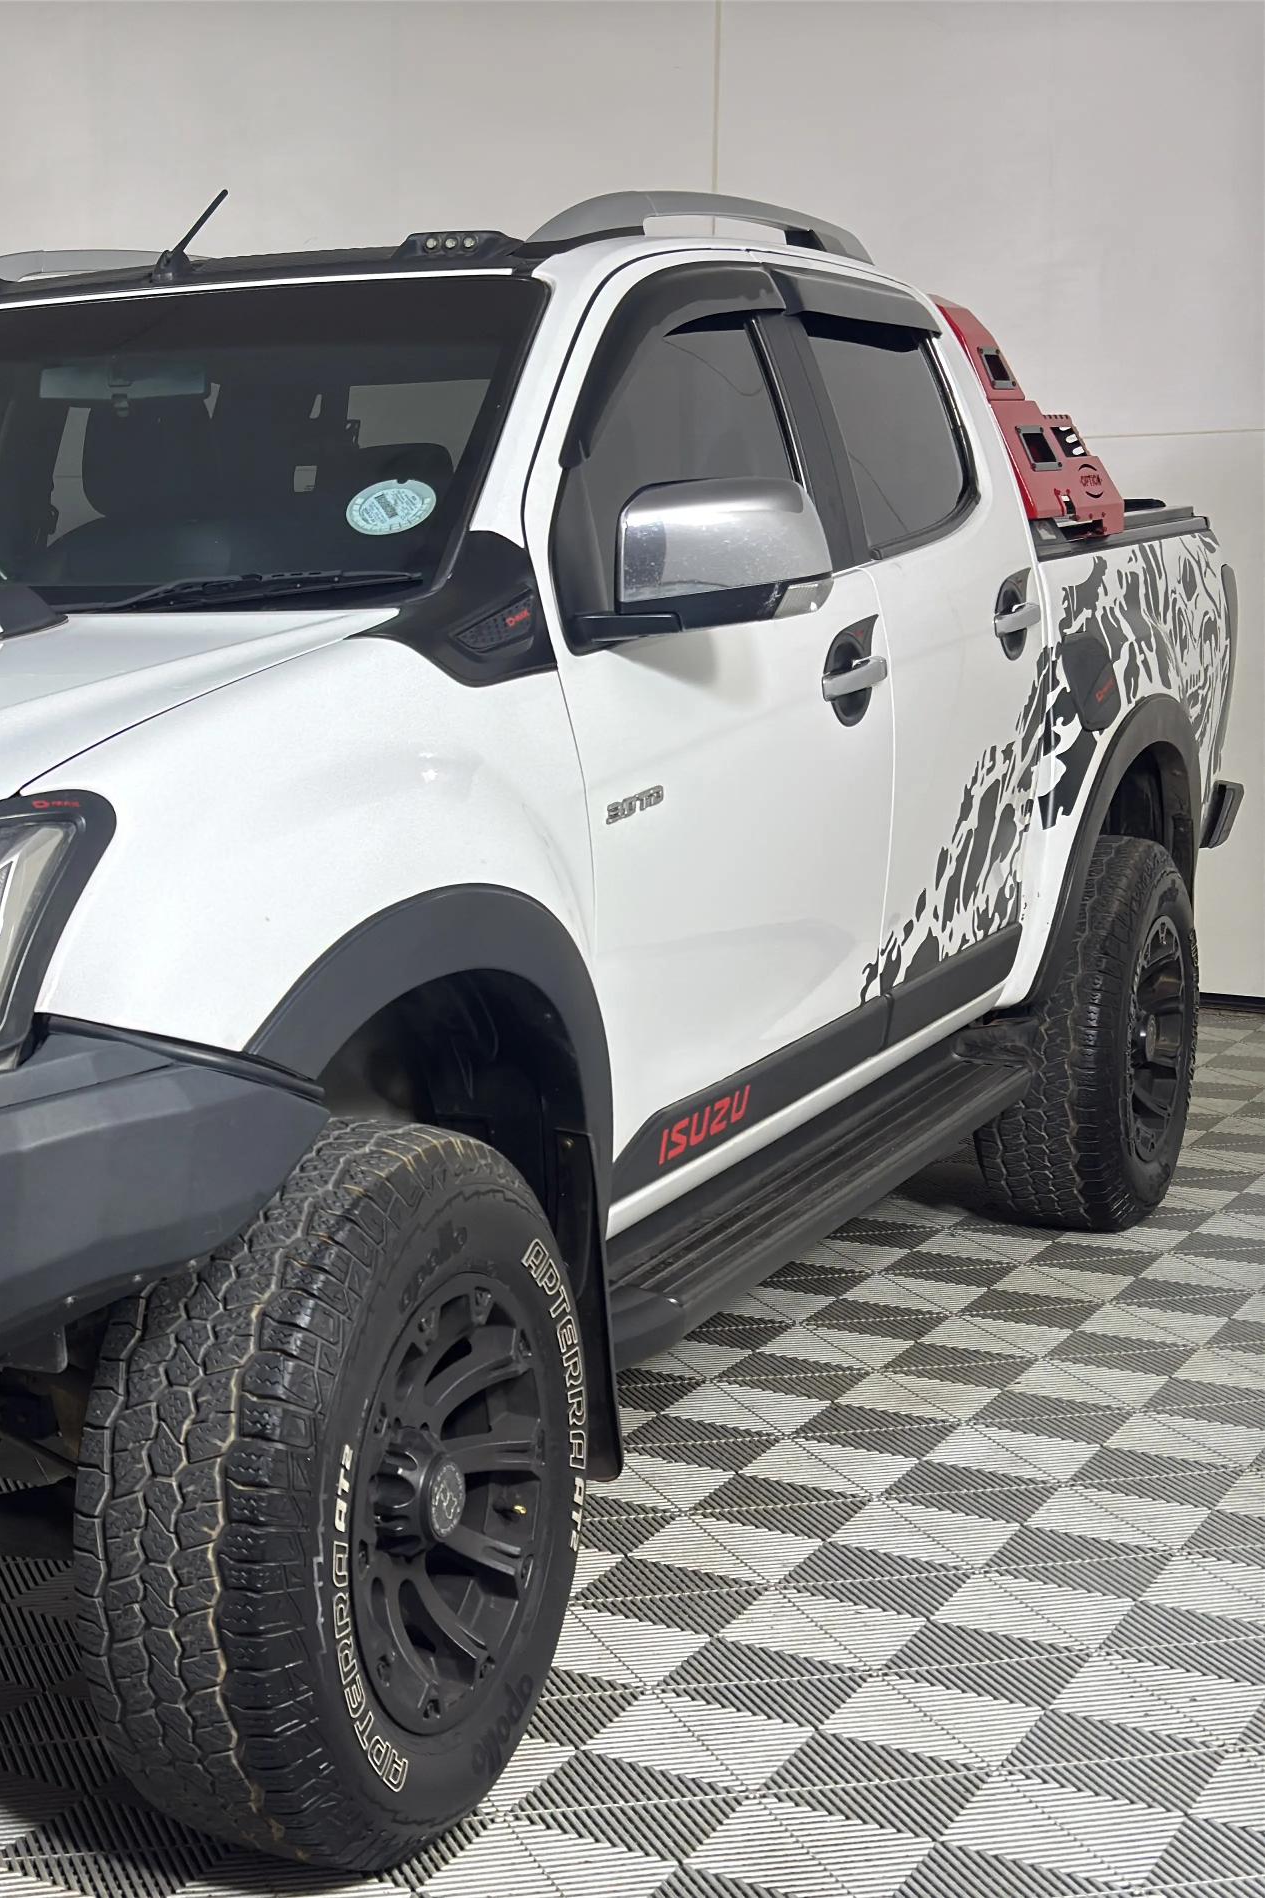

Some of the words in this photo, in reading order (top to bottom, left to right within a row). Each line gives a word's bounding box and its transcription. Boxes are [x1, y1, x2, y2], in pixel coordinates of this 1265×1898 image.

[658, 1083, 751, 1167] ISUZU
[521, 1237, 587, 1471] APTERRA
[332, 1539, 409, 1793] APTERRA
